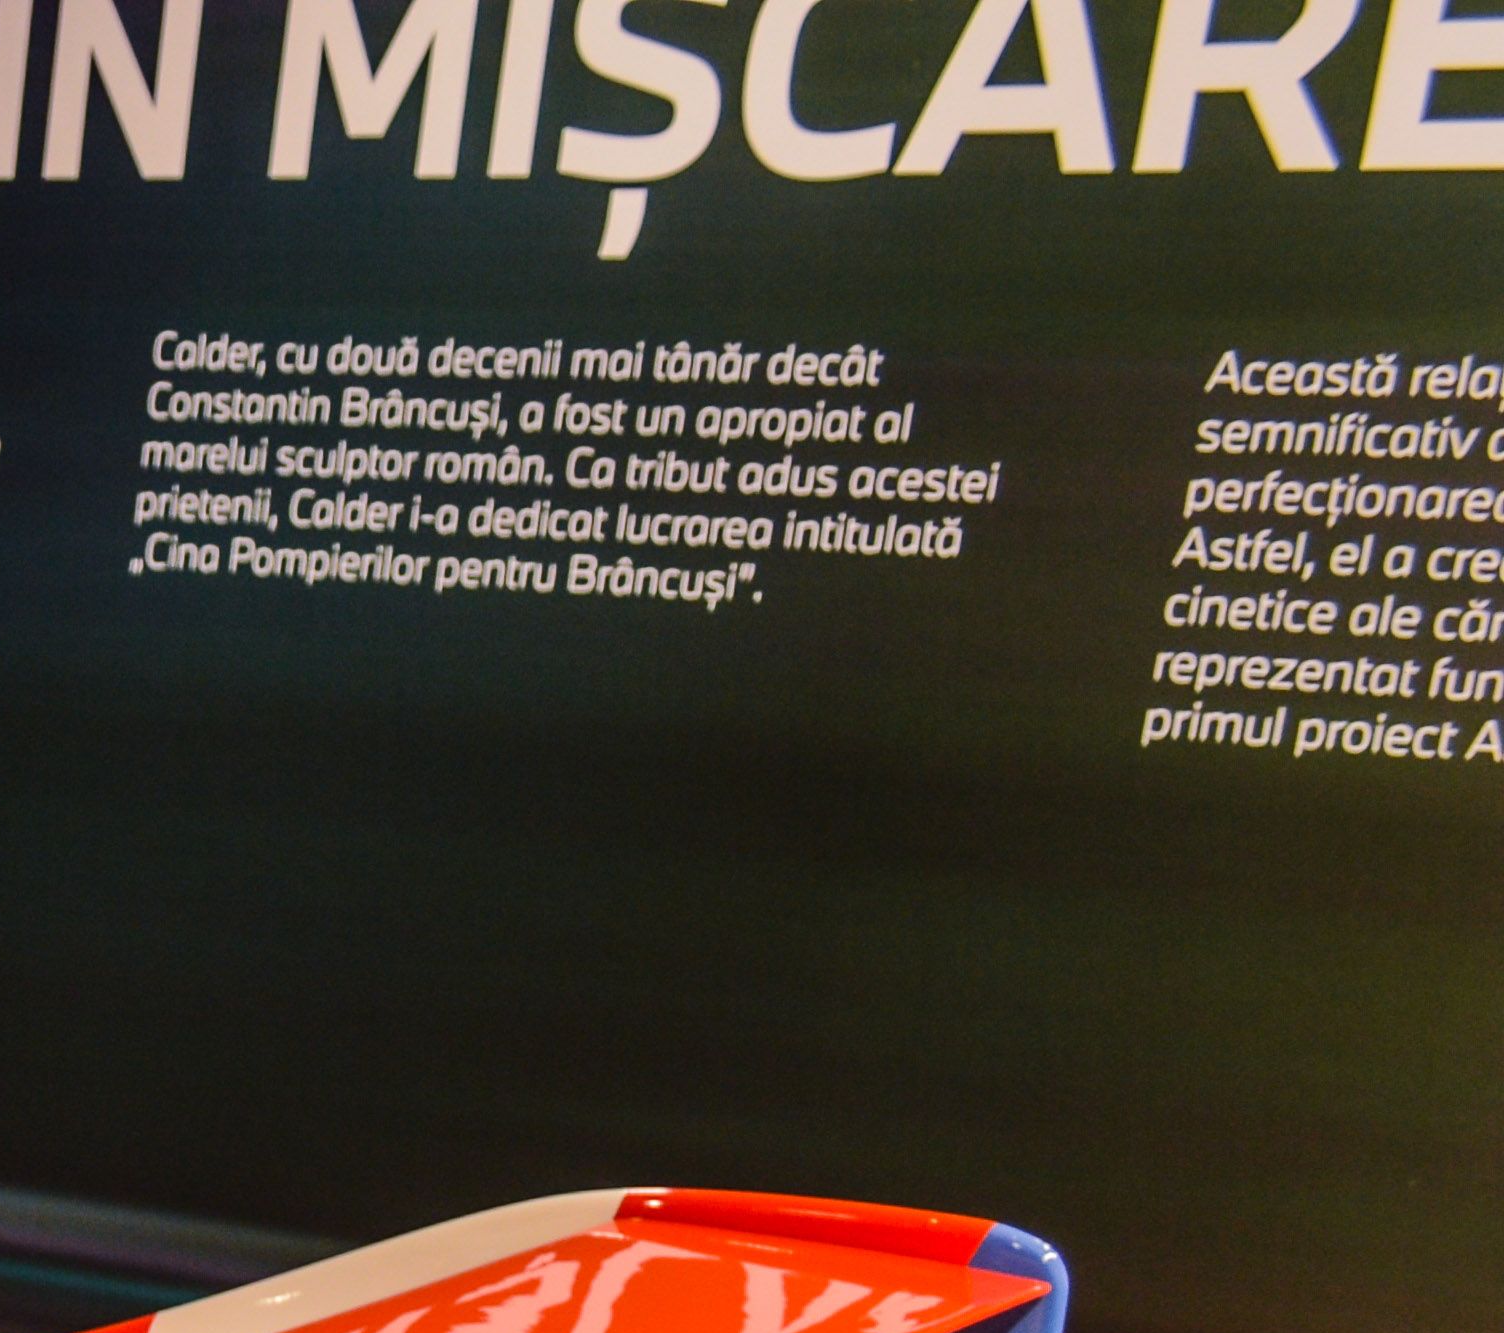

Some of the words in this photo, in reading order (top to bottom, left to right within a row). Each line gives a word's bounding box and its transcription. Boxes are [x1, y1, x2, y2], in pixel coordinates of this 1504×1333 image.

[152, 330, 266, 378] Calder,
[276, 341, 318, 373] cu
[326, 335, 419, 377] două
[428, 337, 563, 379] decenii
[570, 341, 646, 381] mai
[653, 341, 761, 384] tânăr
[767, 343, 886, 388] decât
[1204, 350, 1399, 398] Această
[146, 381, 331, 425] Constantin
[339, 386, 508, 441] Brâncuși,
[519, 401, 545, 434] a
[553, 392, 628, 436] fost
[636, 404, 686, 437] un
[695, 400, 867, 448] apropiat
[874, 402, 915, 444] al
[1195, 412, 1482, 461] semnificativ
[140, 436, 268, 476] marelui
[276, 440, 419, 486] sculptor
[424, 445, 554, 486] român.
[566, 446, 616, 489] Ca
[626, 451, 730, 494] tribut
[737, 455, 838, 498] adus
[848, 462, 1002, 504] acestei
[133, 484, 278, 532] prietenii,
[288, 488, 405, 532] Calder
[409, 495, 459, 536] i-a
[468, 497, 609, 543] dedicat
[615, 503, 774, 550] lucrarea
[783, 510, 963, 559] intitulată
[228, 536, 430, 587] Pompierilor
[434, 554, 557, 594] pentru
[1172, 526, 1316, 582] Astfel,
[1330, 534, 1376, 577] el
[1383, 545, 1416, 580] a
[1427, 546, 1504, 583] cre
[1164, 585, 1340, 635] cinetice
[1349, 595, 1424, 640] ale
[1153, 651, 1421, 698] reprezentat
[1140, 701, 1287, 748] primul
[1293, 713, 1460, 760] proiect
